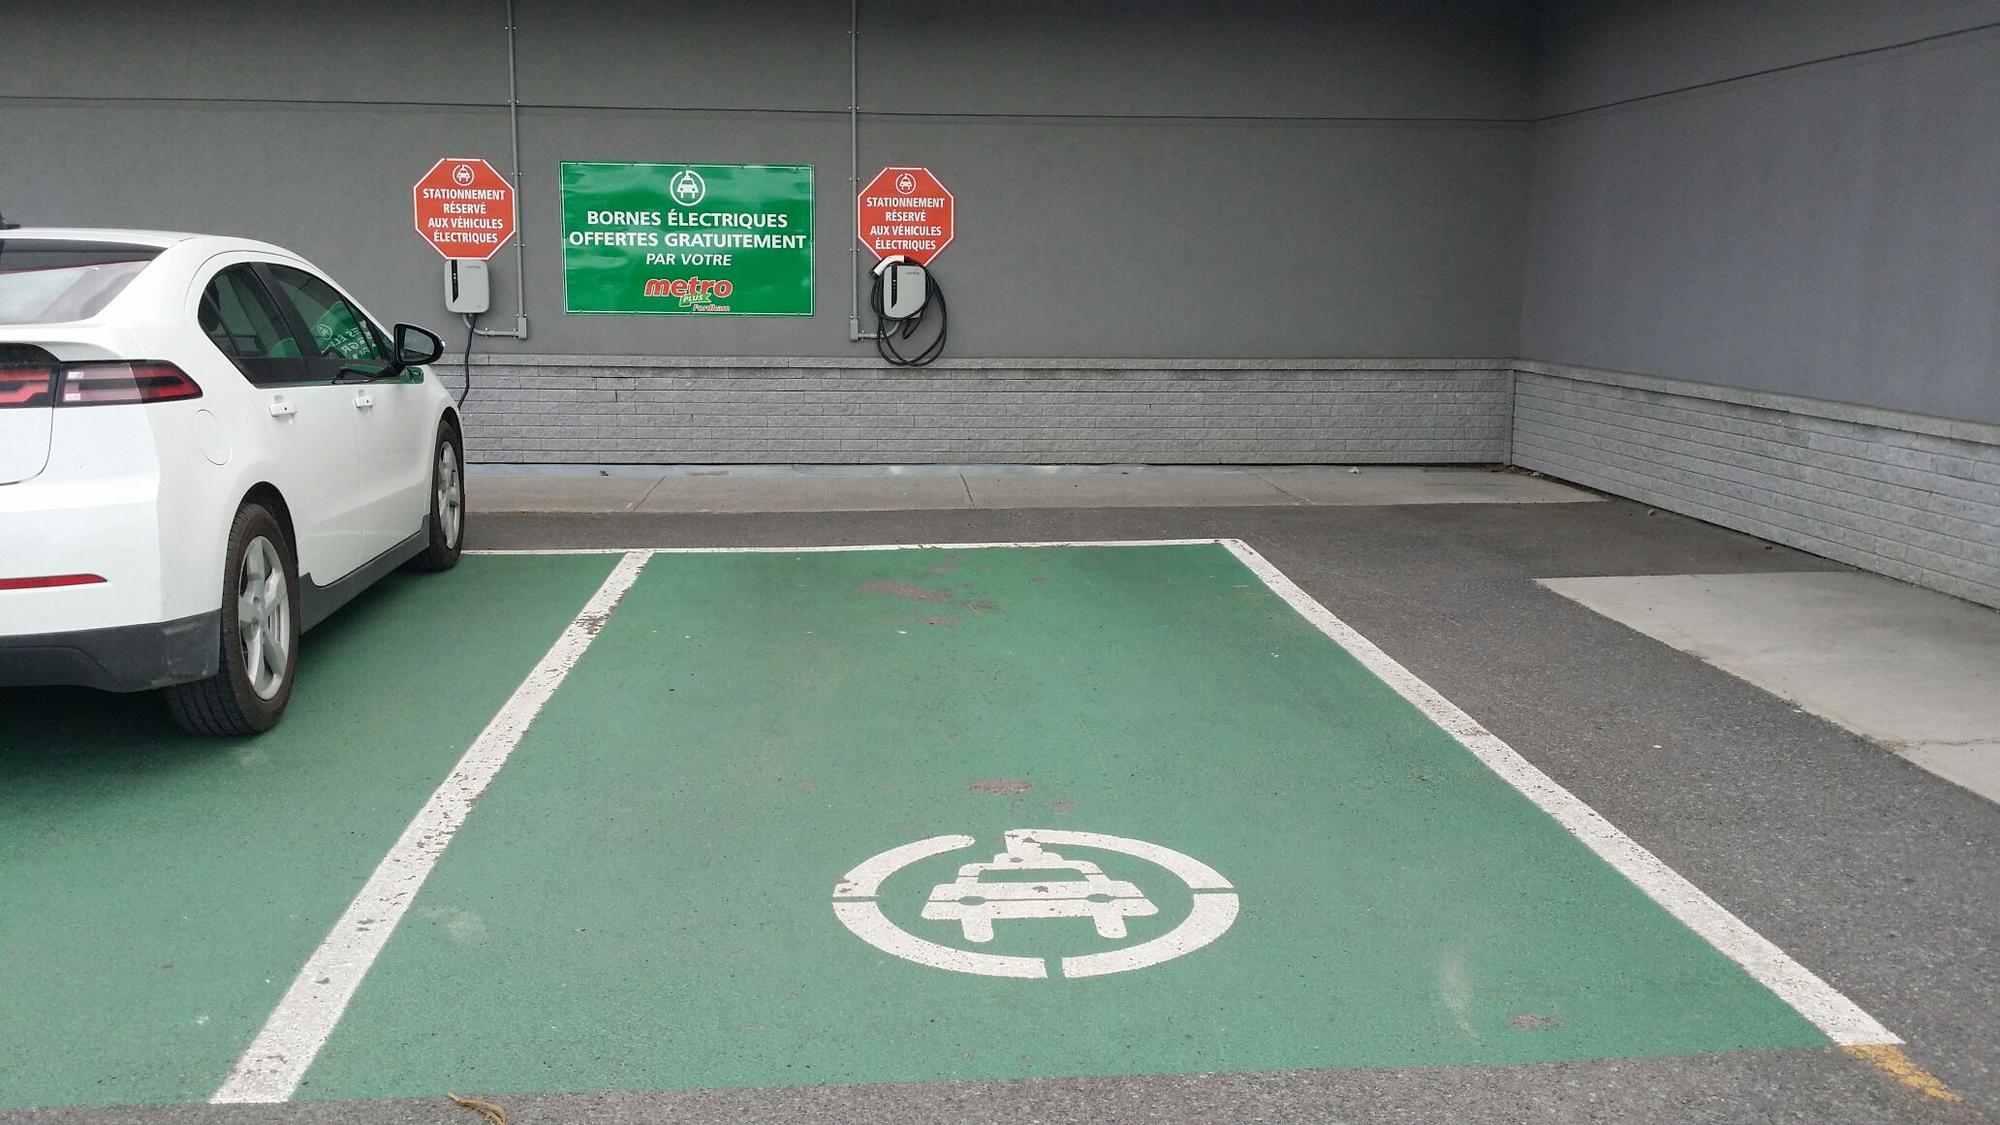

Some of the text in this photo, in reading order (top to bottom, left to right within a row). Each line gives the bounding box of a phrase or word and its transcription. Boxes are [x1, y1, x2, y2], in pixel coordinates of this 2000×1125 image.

[423, 188, 505, 200] STATIONNEMENT
[443, 201, 486, 214] RÉSERVÉ
[866, 197, 945, 208] STATIONNEMENT
[428, 215, 503, 229] AUX VÉHICULES
[587, 208, 788, 229] BORNES ÉLECTRIQUES
[885, 209, 927, 222] RÉSERVÉ
[870, 223, 942, 236] AUX VÉHICULES
[433, 229, 498, 244] ÉLECTRIQUES
[569, 231, 807, 249] OFFERTES GRATUITEMENT
[875, 237, 936, 251] ÉLECTRIQUES
[645, 253, 732, 266] PAR VOTRE
[644, 276, 733, 298] metro
